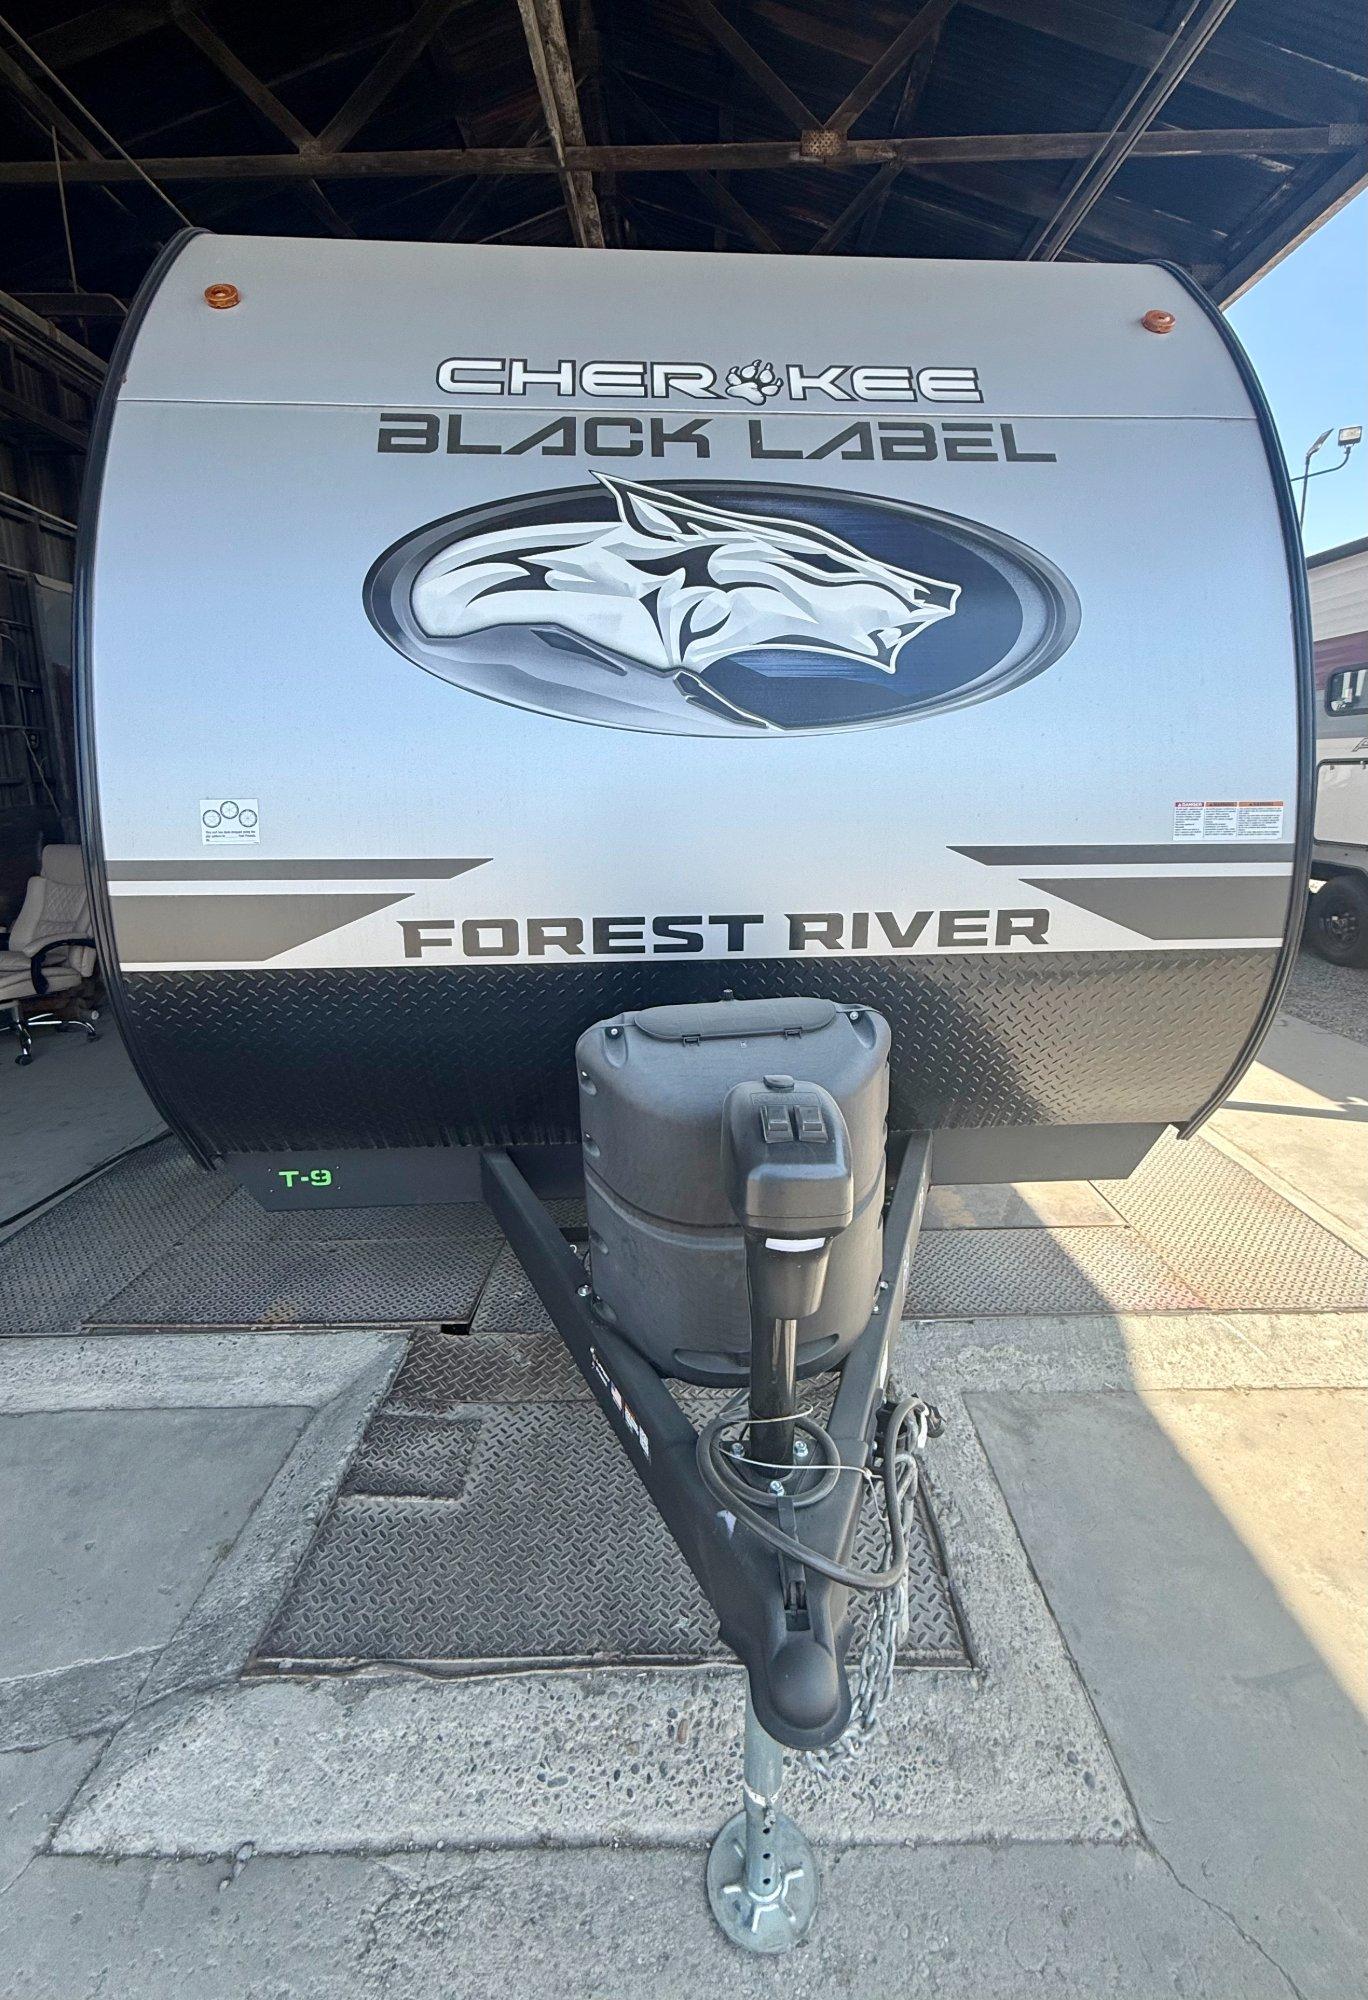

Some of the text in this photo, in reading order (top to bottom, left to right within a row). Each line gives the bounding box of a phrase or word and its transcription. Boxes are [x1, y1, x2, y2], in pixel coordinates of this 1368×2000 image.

[378, 412, 1057, 462] BLACK LABEL
[396, 909, 1050, 958] FOREST RIVER
[278, 1169, 332, 1188] T-9
